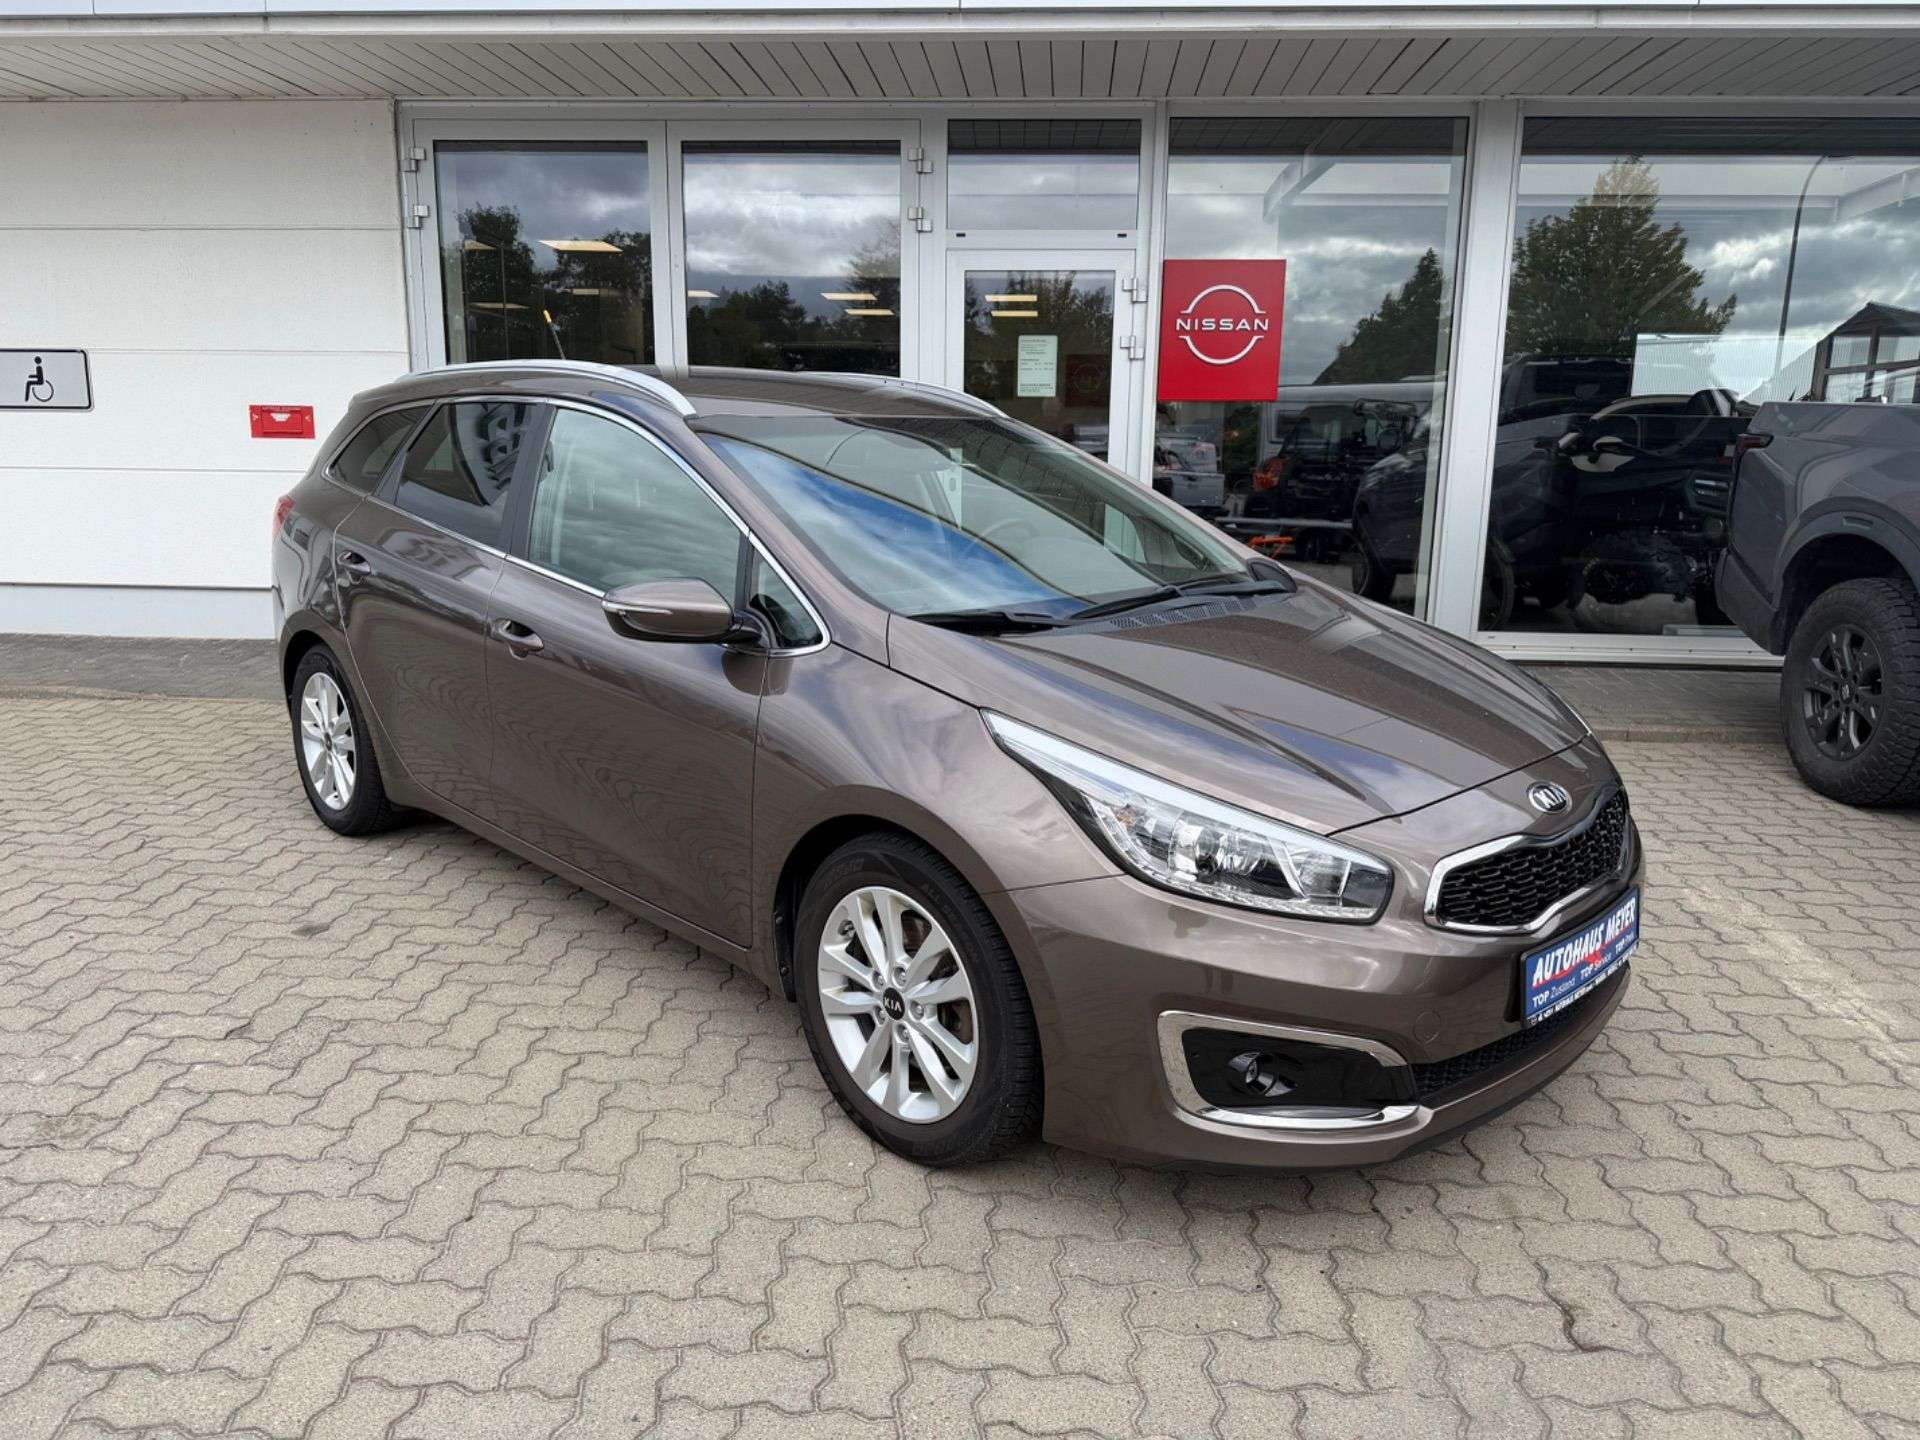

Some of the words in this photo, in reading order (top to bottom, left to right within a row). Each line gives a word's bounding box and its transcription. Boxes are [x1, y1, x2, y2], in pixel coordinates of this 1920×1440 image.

[1176, 318, 1269, 331] NISSAN
[1532, 923, 1605, 988] AUTOHAUS
[1604, 897, 1636, 945] MEYER
[1580, 963, 1594, 981] TOP
[884, 997, 902, 1013] KIA
[1532, 990, 1550, 1008] TOP
